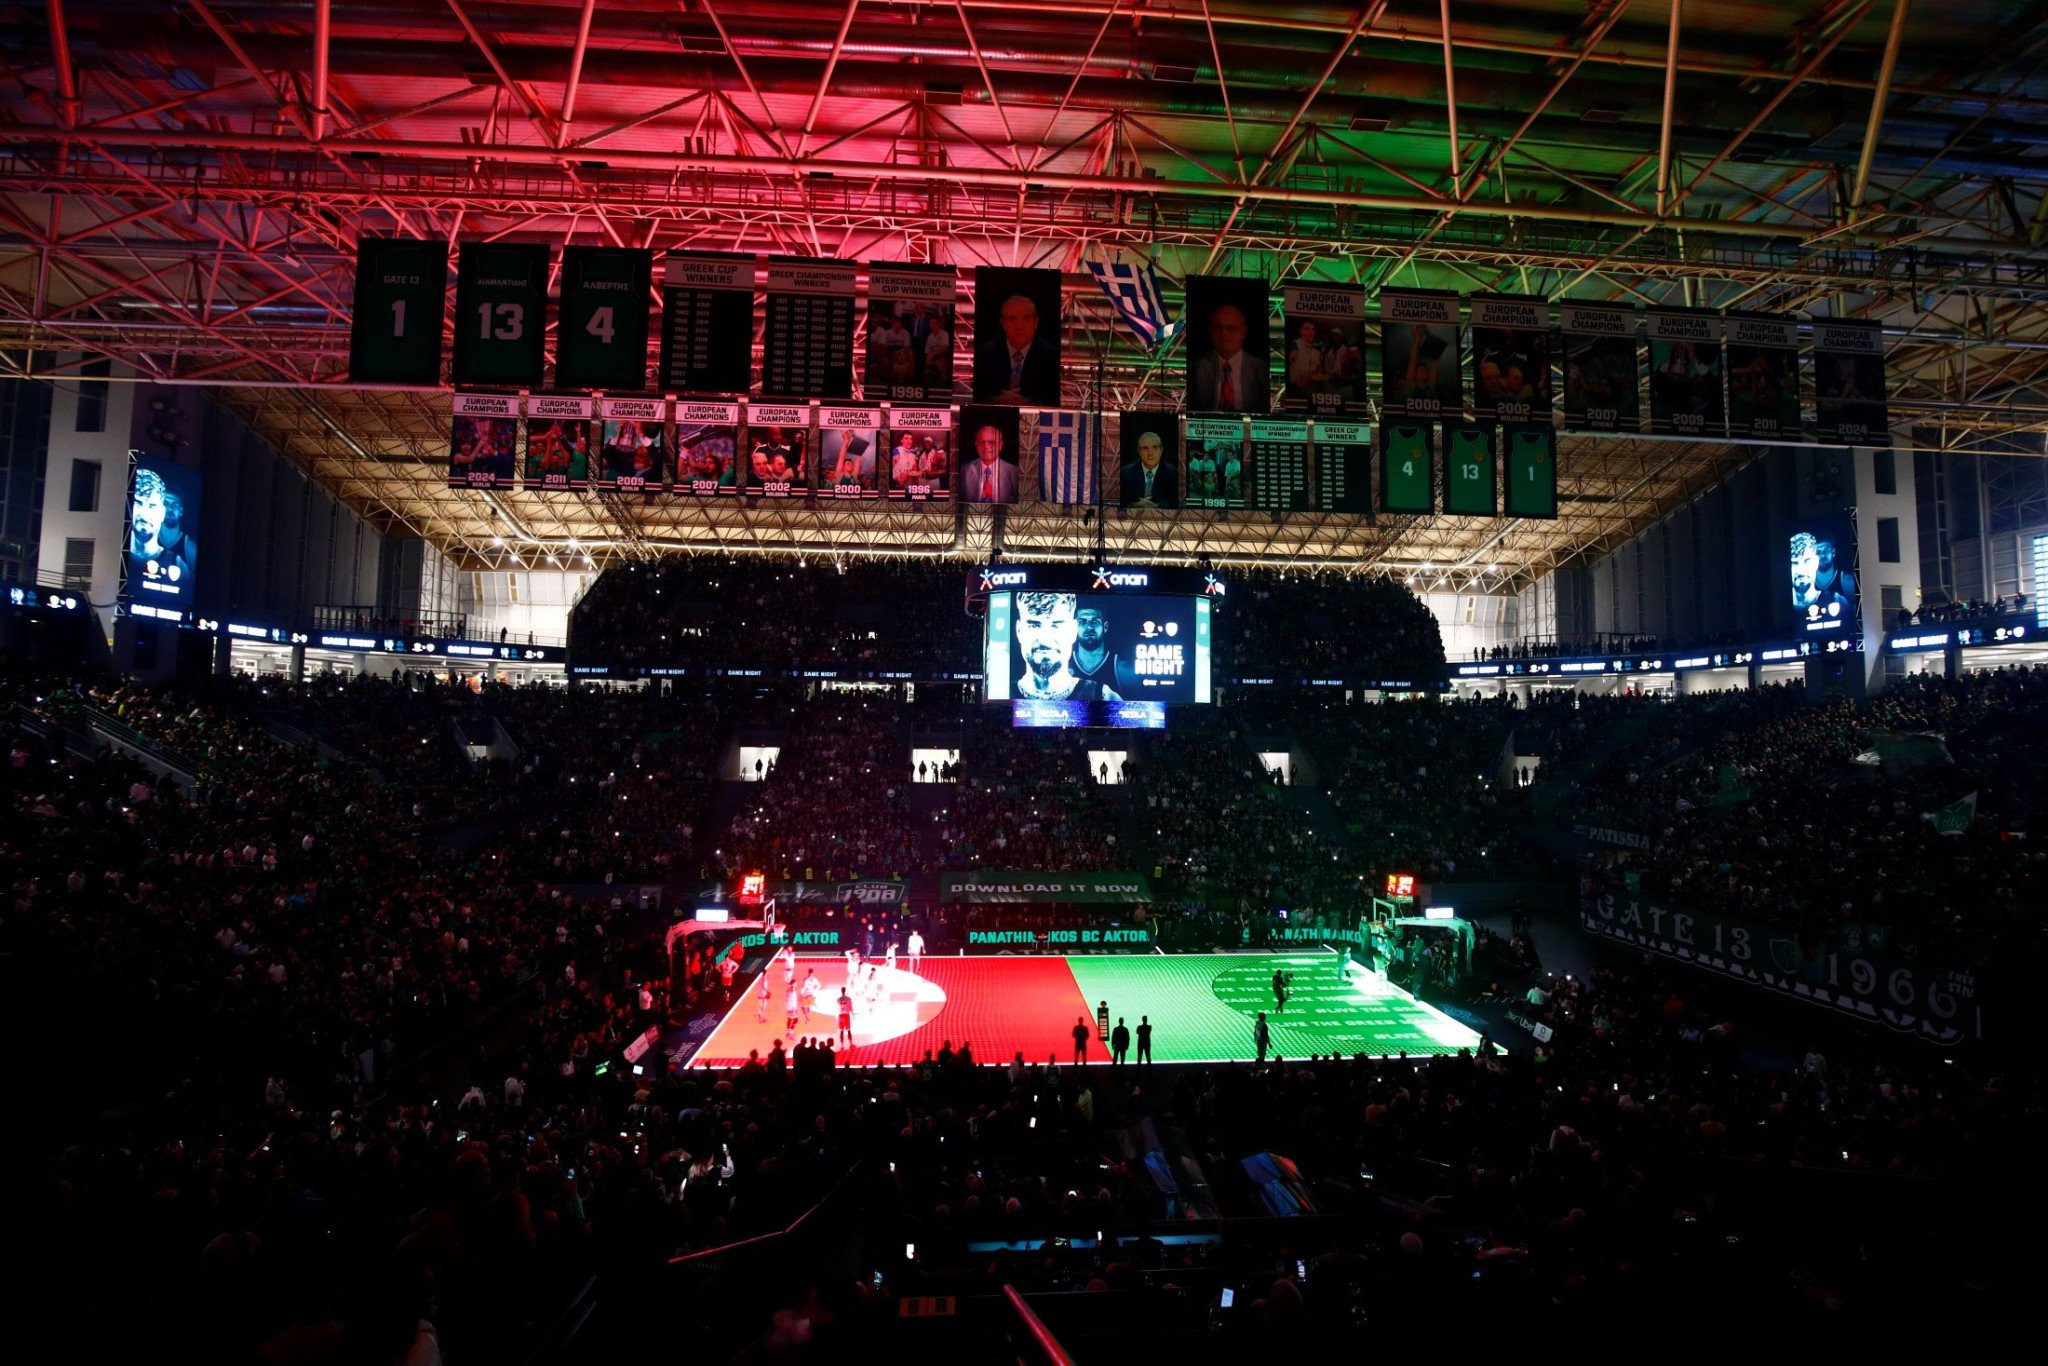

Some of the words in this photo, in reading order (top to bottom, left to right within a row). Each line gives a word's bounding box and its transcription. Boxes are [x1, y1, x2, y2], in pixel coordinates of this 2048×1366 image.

[683, 263, 715, 273] GREEK
[718, 266, 738, 274] CUP
[384, 274, 408, 285] GATE
[409, 275, 420, 285] 13
[685, 273, 733, 284] WINNERS
[770, 270, 794, 278] GREEK
[796, 272, 856, 282] CHAMPIONSHIP
[794, 279, 830, 288] WINNERS
[872, 276, 952, 288] INTERCONTINENTAL
[882, 285, 899, 294] CUP
[901, 287, 941, 296] WINNERS
[1299, 293, 1350, 304] EUROPEAN
[1296, 302, 1354, 314] CHAMPIONS
[1395, 299, 1445, 310] EUROPEAN
[1486, 305, 1534, 315] EUROPEAN
[391, 299, 406, 337] 1
[1392, 308, 1449, 320] CHAMPIONS
[1482, 313, 1538, 325] CHAMPIONS
[1574, 312, 1622, 322] EUROPEAN
[478, 302, 525, 341] 13
[585, 306, 615, 344] 4
[1571, 320, 1625, 332] CHAMPIONS
[1660, 318, 1707, 329] EUROPEAN
[1658, 327, 1711, 338] CHAMPIONS
[1739, 323, 1784, 334] EUROPEAN
[1736, 332, 1787, 344] CHAMPIONS
[1825, 330, 1870, 340] EUROPEAN
[1823, 338, 1874, 350] CHAMPIONS
[891, 385, 923, 399] 1996
[466, 398, 507, 407] EUROPEAN
[540, 400, 580, 408] EUROPEAN
[1311, 393, 1341, 405] 1996
[1406, 398, 1440, 411] 2000
[462, 404, 509, 414] CHAMPIONS
[537, 406, 582, 415] CHAMPIONS
[614, 402, 654, 410] EUROPEAN
[687, 406, 727, 414] EUROPEAN
[1498, 403, 1530, 415] 2002
[610, 408, 656, 417] CHAMPIONS
[684, 412, 729, 421] CHAMPIONS
[830, 410, 870, 419] EUROPEAN
[901, 412, 940, 420] EUROPEAN
[1586, 408, 1618, 420] 2007
[756, 415, 801, 424] CHAMPIONS
[827, 417, 872, 426] CHAMPIONS
[898, 418, 942, 427] CHAMPIONS
[1672, 414, 1704, 425] 2009
[1754, 419, 1777, 429] 2011
[1188, 423, 1241, 431] INTERCONTINENTAL
[1839, 424, 1868, 435] 2024
[1327, 433, 1357, 441] WINNERS
[1402, 461, 1413, 476] 4
[1462, 464, 1479, 479] 13
[1528, 466, 1534, 481] 1
[468, 473, 495, 482] 2024
[545, 474, 566, 484] 2011
[617, 476, 644, 486] 2009
[692, 480, 718, 490] 2007
[763, 482, 790, 492] 2002
[834, 485, 861, 494] 2000
[908, 485, 930, 494] 1996
[1204, 498, 1225, 507] 1996
[1135, 644, 1183, 660] GAME
[1134, 659, 1184, 676] NIGHT
[951, 884, 1061, 893] DOWNLOAD
[1070, 884, 1086, 893] IT
[1095, 885, 1138, 893] NOW
[840, 889, 896, 903] 1908
[793, 932, 839, 944] AKTOR
[1082, 930, 1099, 943] BC
[1103, 930, 1147, 943] AKTOR
[1597, 894, 1696, 946] GATE
[1713, 923, 1752, 960] 13
[1827, 953, 1957, 1018] 1966
